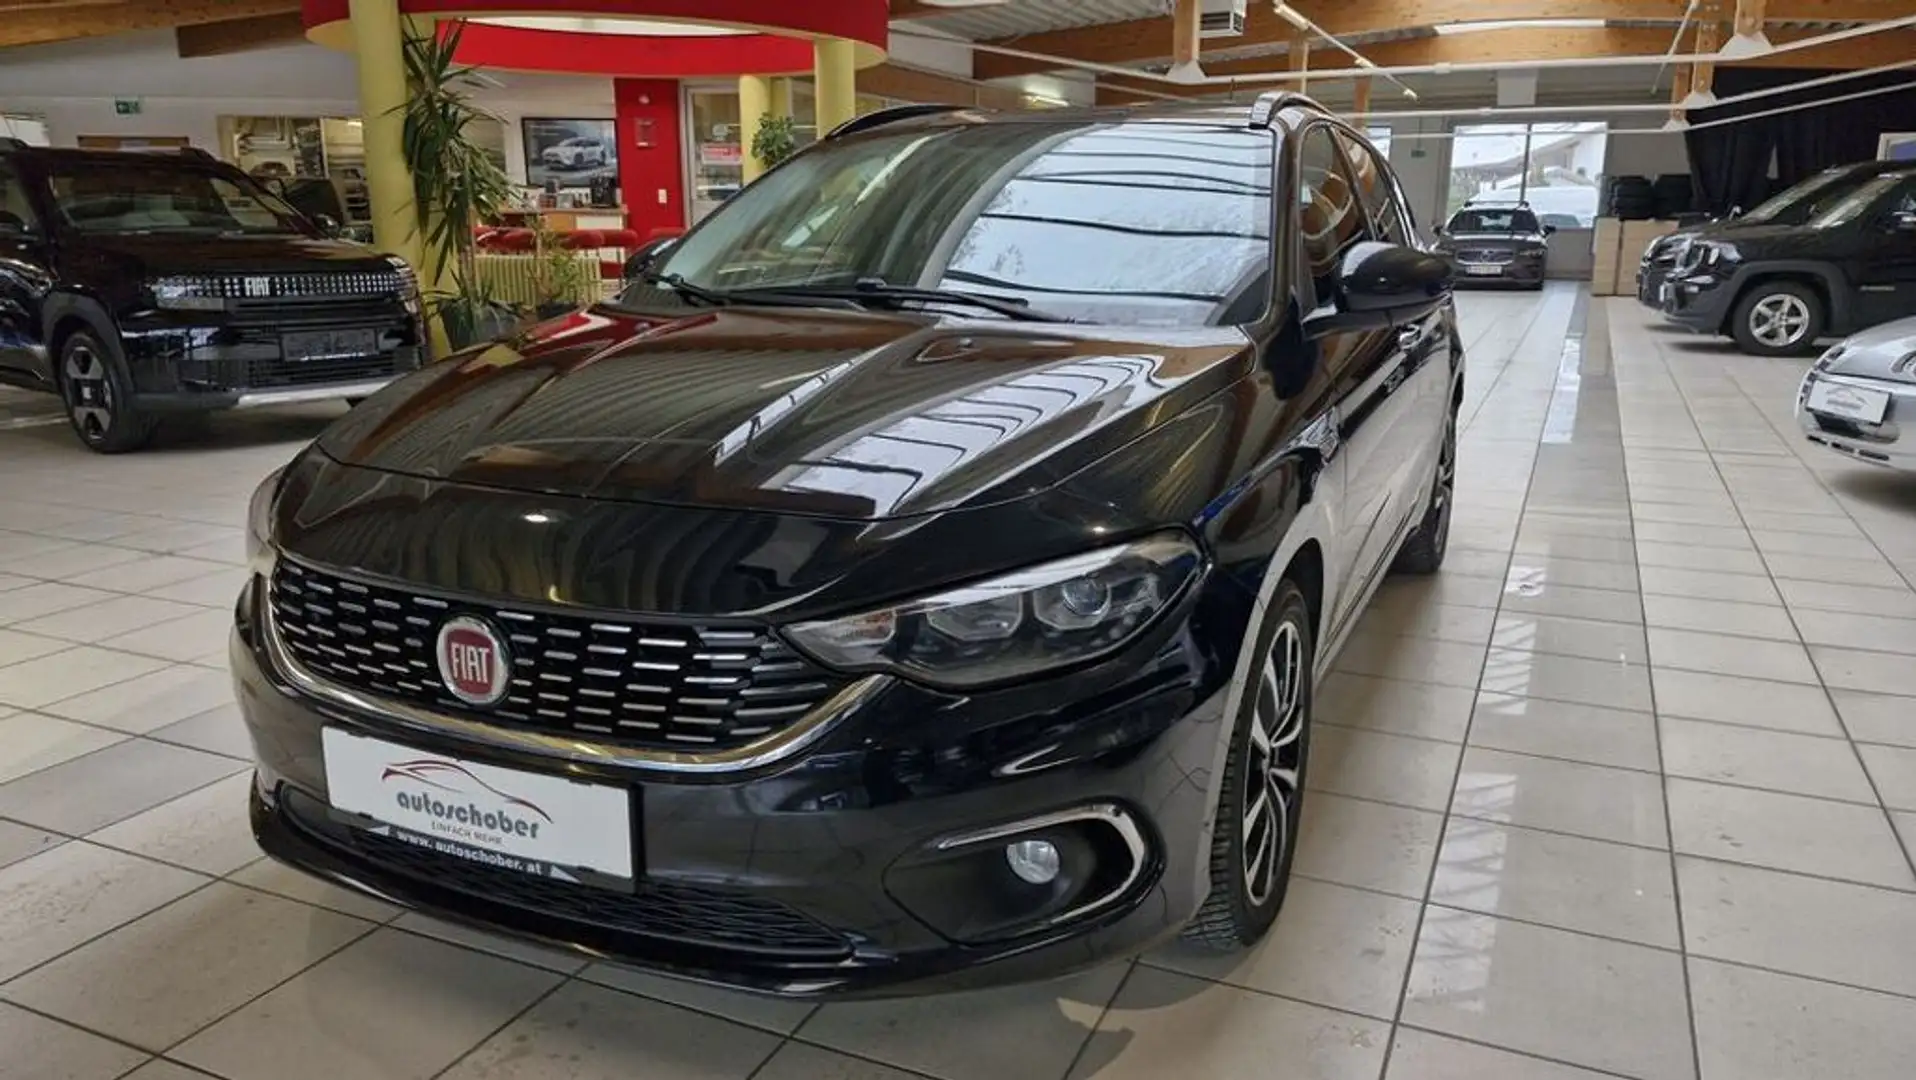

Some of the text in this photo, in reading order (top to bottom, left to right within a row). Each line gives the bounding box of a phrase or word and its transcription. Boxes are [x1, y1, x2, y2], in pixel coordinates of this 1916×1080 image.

[244, 276, 270, 296] FIAT
[450, 641, 490, 684] FIAT
[397, 791, 539, 839] autoschober
